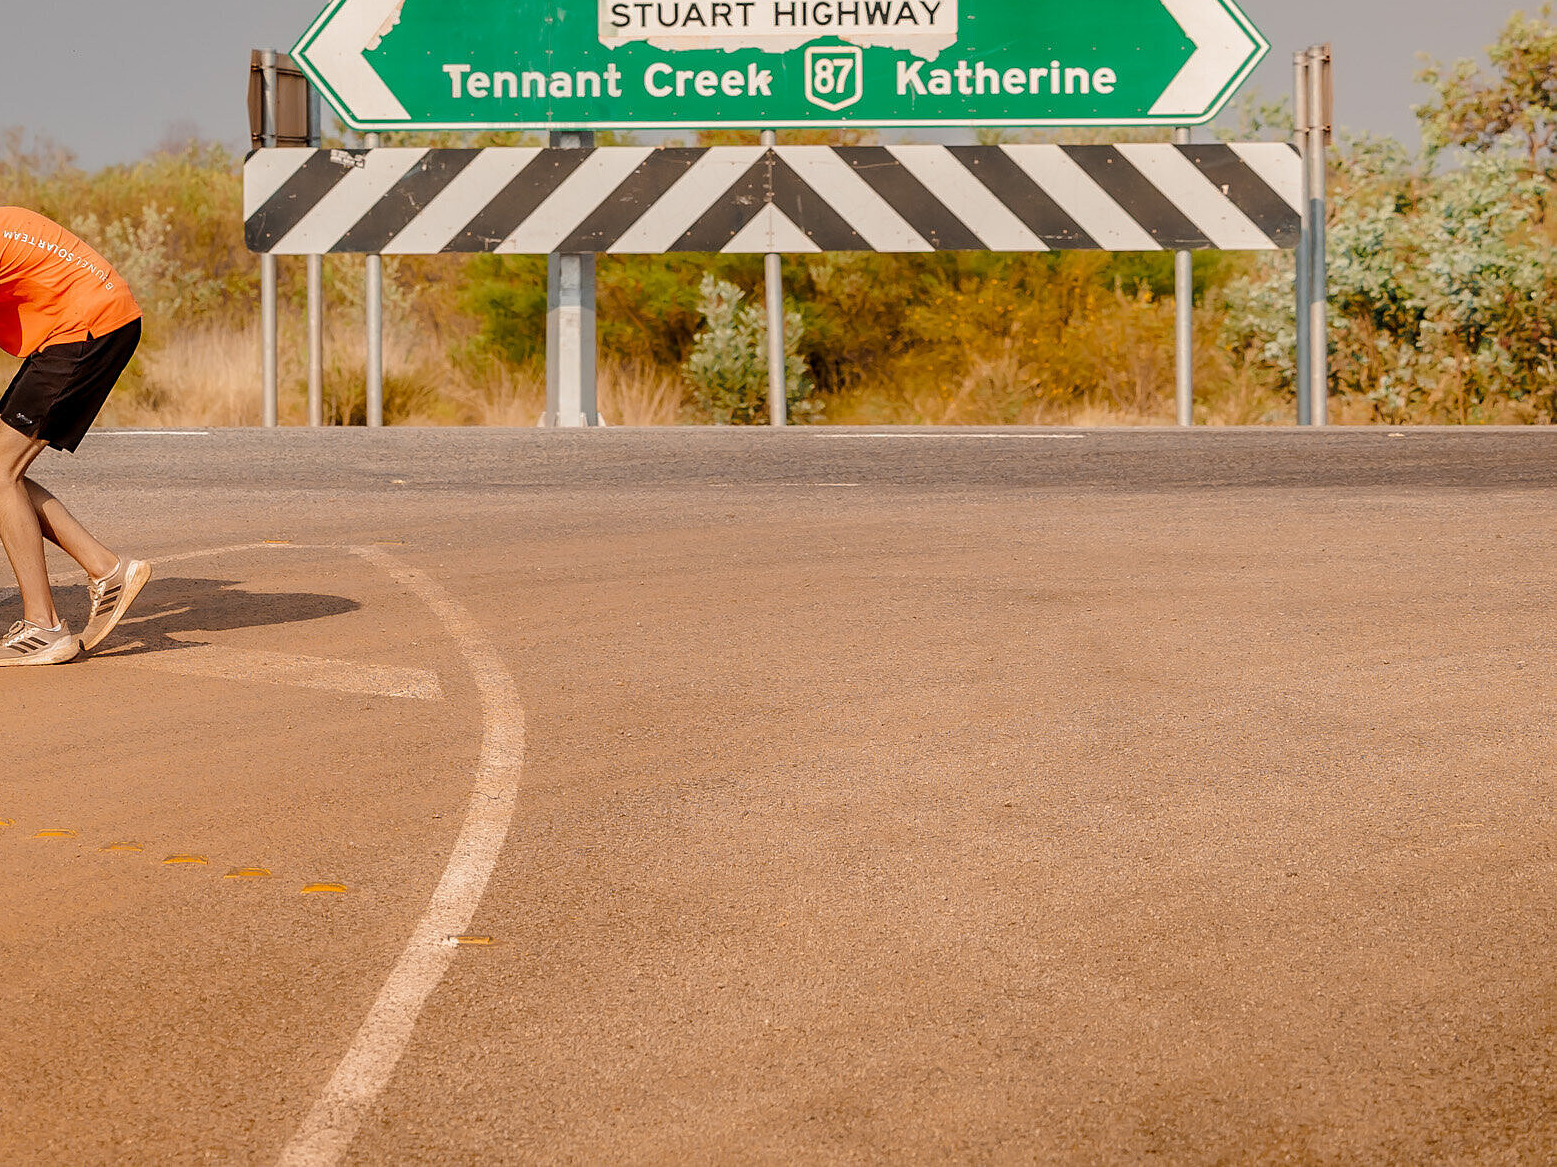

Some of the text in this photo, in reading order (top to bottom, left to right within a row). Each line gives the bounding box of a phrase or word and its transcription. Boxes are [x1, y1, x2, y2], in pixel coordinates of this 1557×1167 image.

[611, 0, 941, 28] STUART HIGHWAY
[442, 61, 773, 99] Tennant Creek
[813, 57, 854, 95] 87
[895, 59, 1117, 96] Katherine
[3, 229, 36, 246] TEAM
[37, 239, 74, 262] SOLAR
